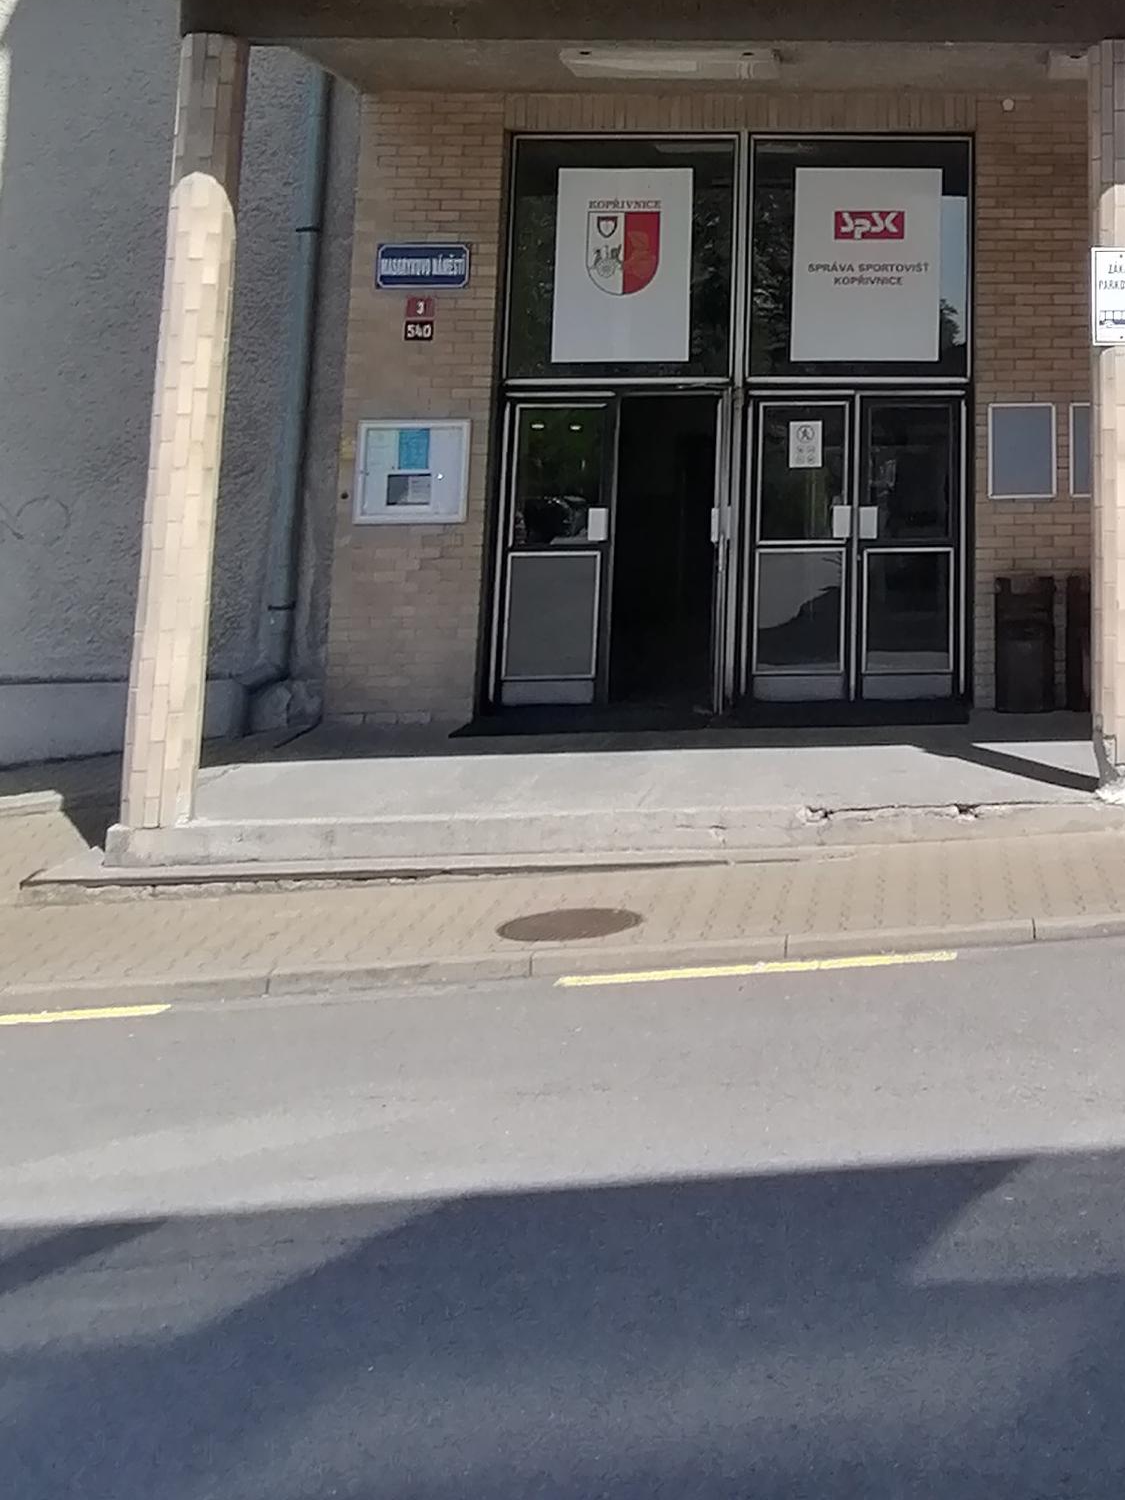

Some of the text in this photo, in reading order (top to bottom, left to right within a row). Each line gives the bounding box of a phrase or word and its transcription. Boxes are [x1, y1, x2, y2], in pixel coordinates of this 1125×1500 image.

[588, 198, 662, 209] KOPŘIVNICE
[808, 261, 855, 273] SPRÁVA
[833, 275, 903, 286] KOPŘIVNICE
[416, 301, 425, 315] 3
[406, 324, 432, 338] 540
